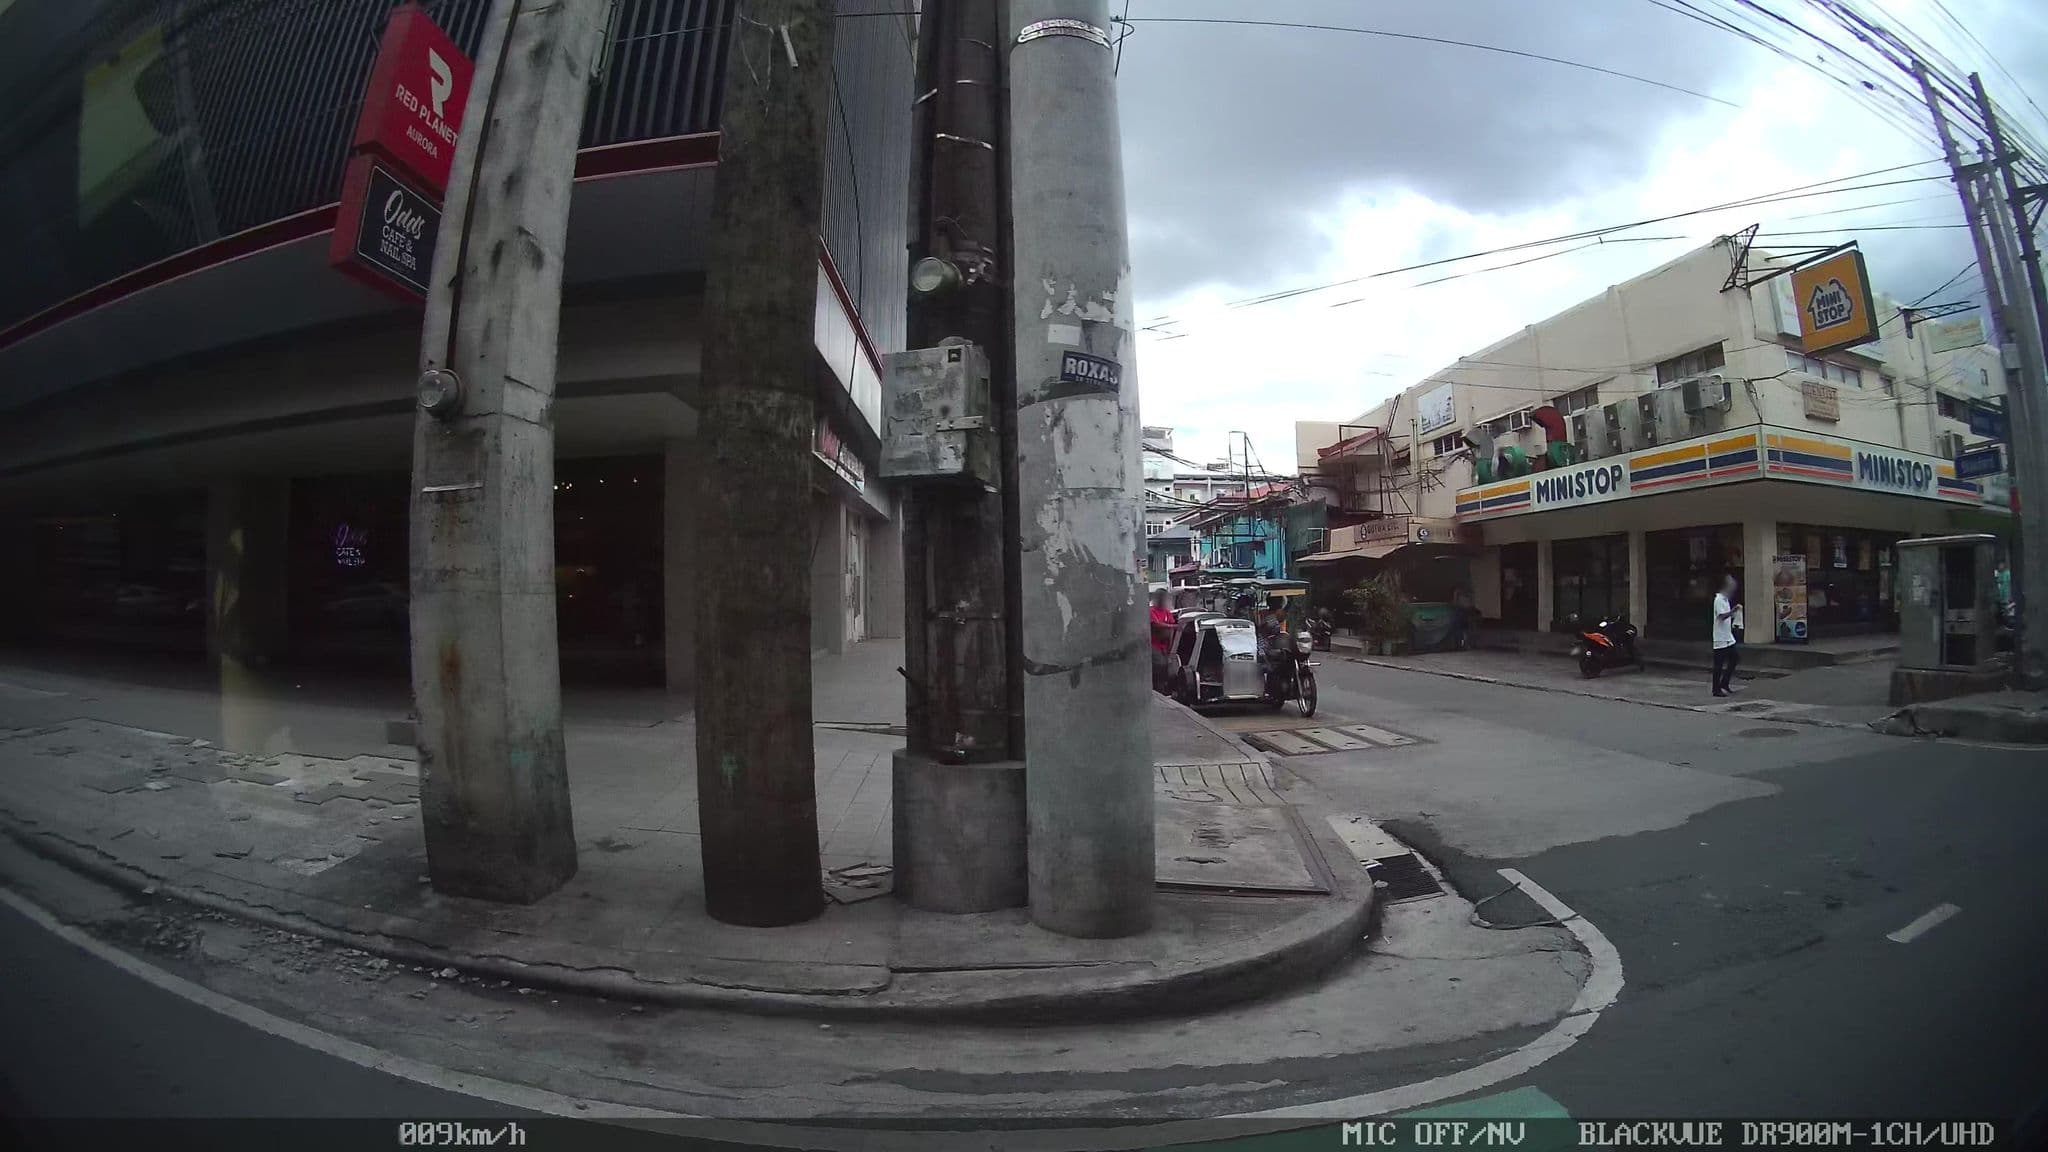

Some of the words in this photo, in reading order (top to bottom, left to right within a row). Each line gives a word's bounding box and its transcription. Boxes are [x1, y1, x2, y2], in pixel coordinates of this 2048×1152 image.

[396, 83, 418, 112] RED
[419, 104, 459, 147] PLANET
[406, 124, 438, 160] AURORA
[384, 190, 425, 240] Odds
[380, 239, 401, 262] NAIL
[400, 251, 417, 271] SPA
[1816, 290, 1842, 310] MINI
[1817, 303, 1844, 324] STOP
[1536, 463, 1624, 504] MINISTOP
[1857, 452, 1933, 491] MINISTOP
